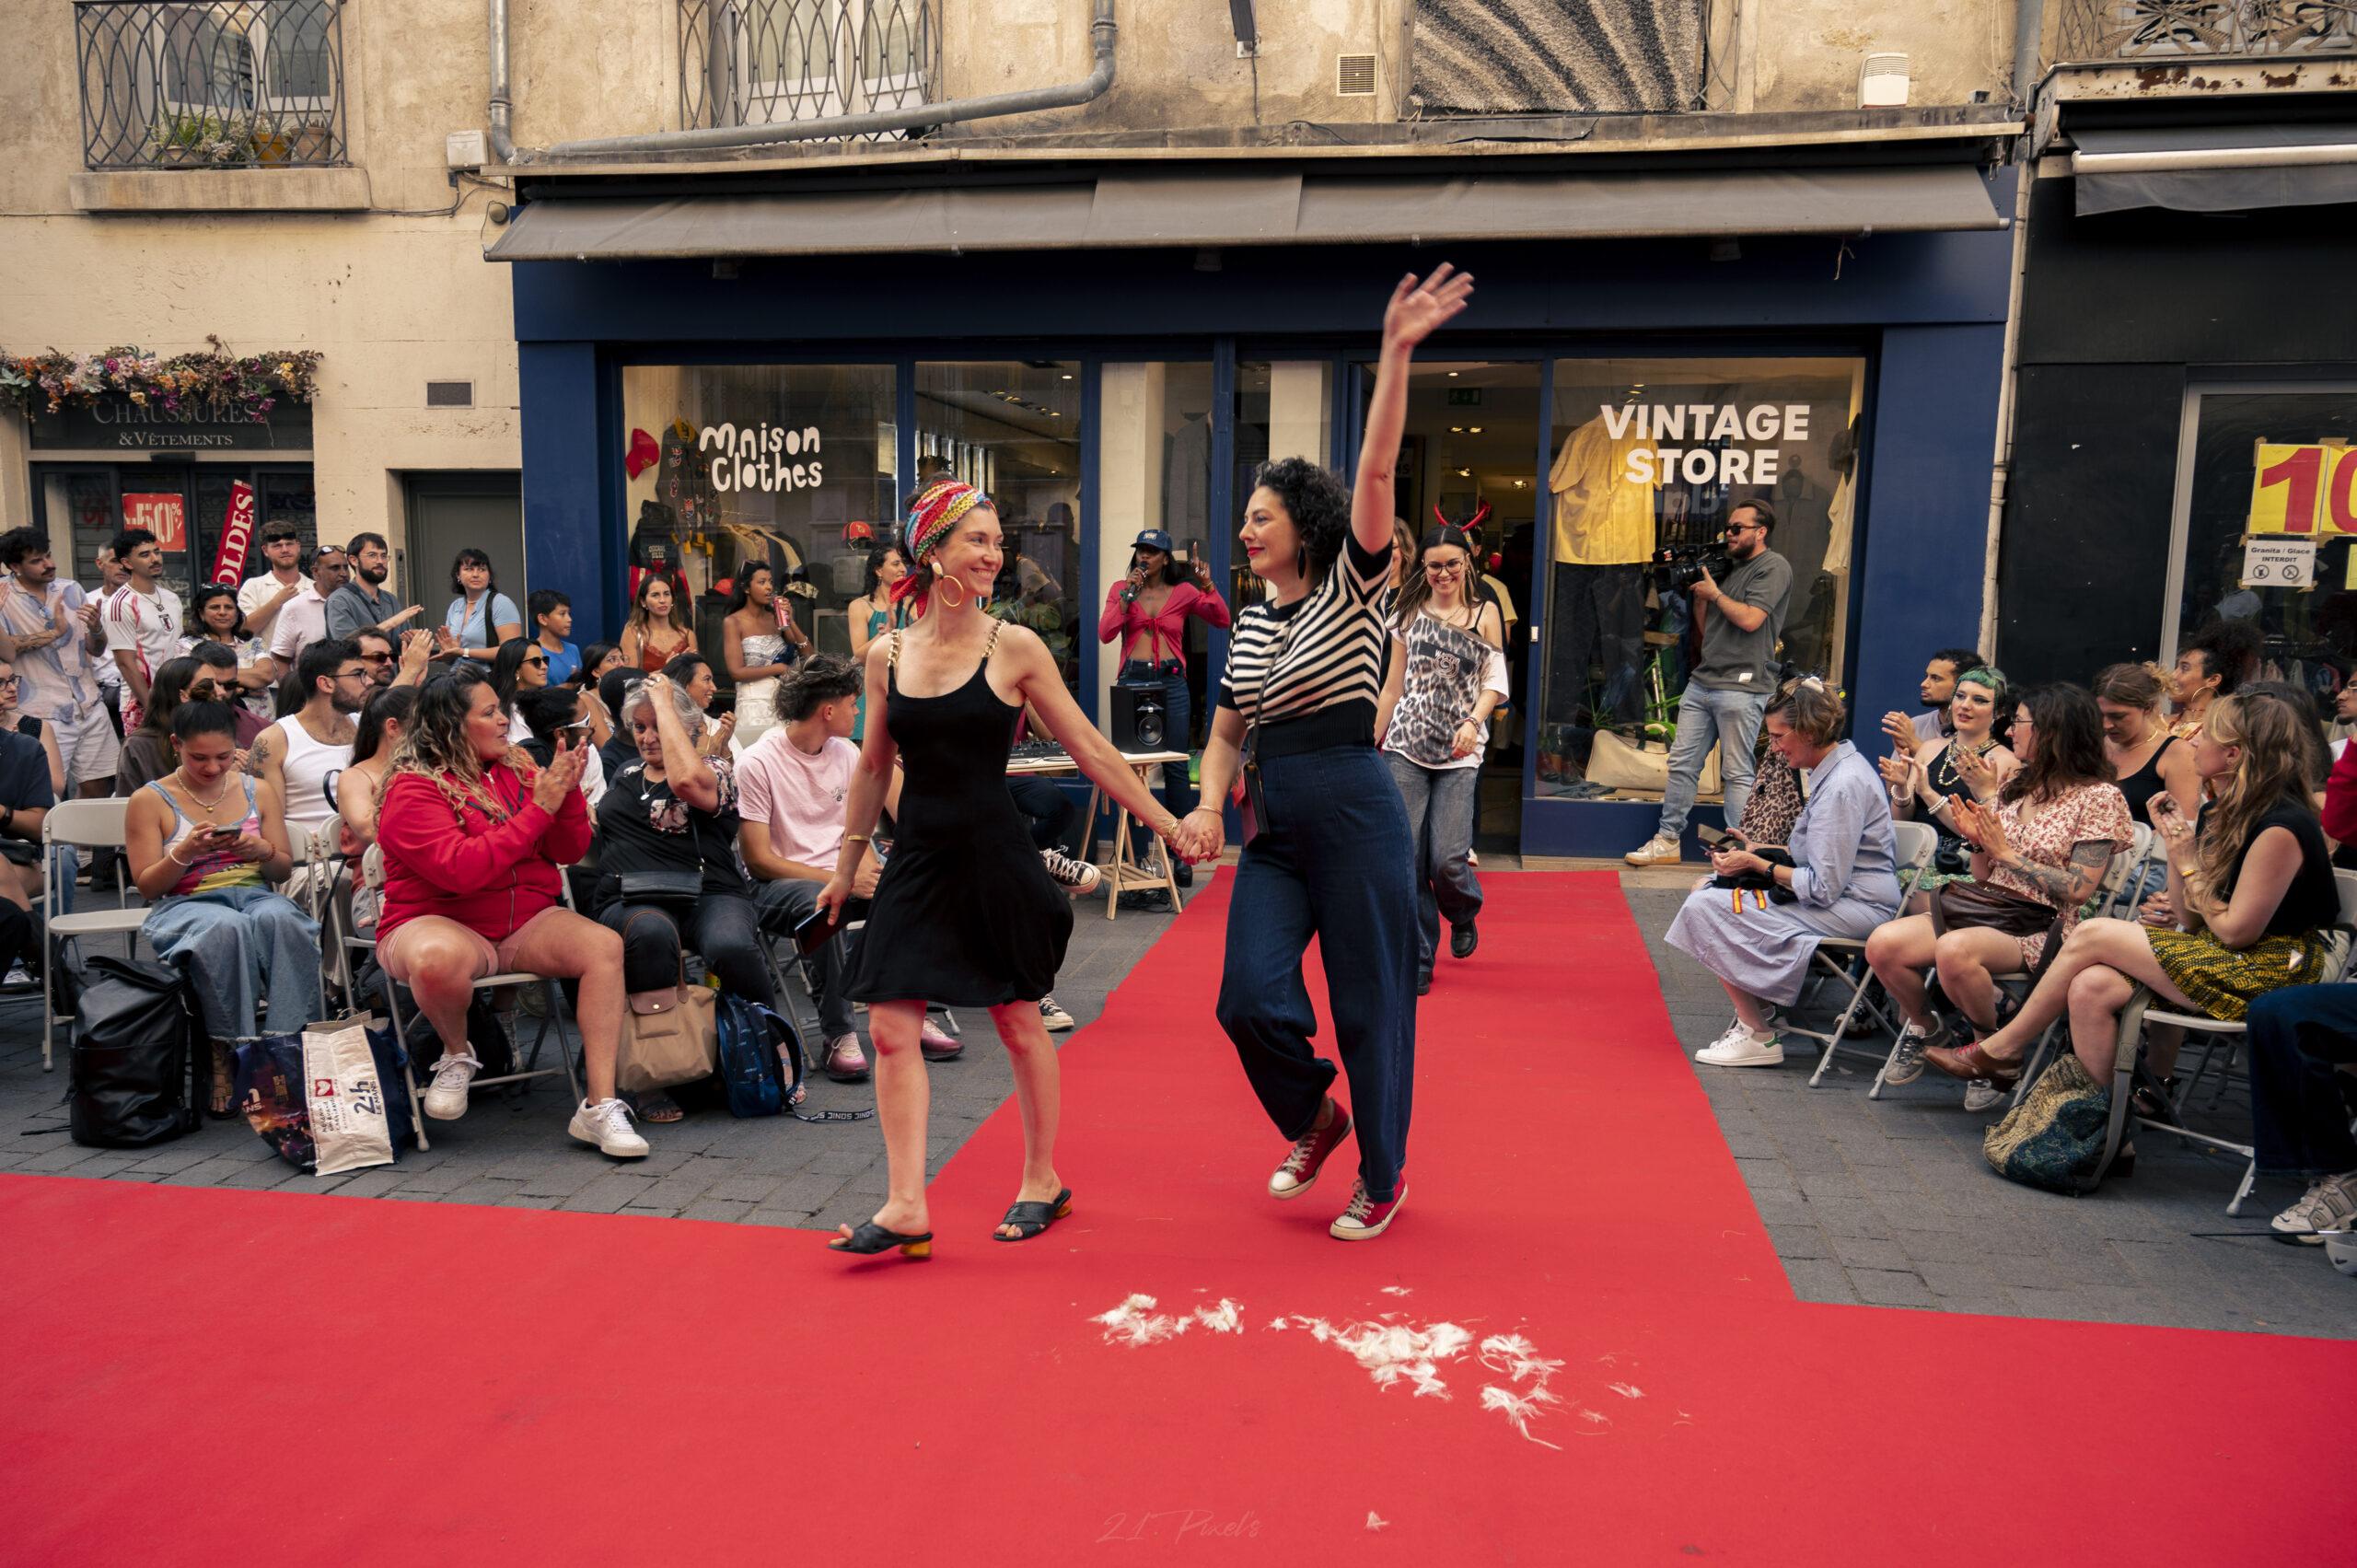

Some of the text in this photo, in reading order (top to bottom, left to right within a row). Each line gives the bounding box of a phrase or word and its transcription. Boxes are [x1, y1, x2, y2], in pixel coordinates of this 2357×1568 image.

[1600, 403, 1811, 441] VINTAGE
[712, 452, 823, 492] Clothes
[1625, 448, 1780, 484] STORE
[216, 494, 254, 587] OLDES
[370, 1081, 379, 1103] MANS
[827, 1111, 853, 1120] SONIC
